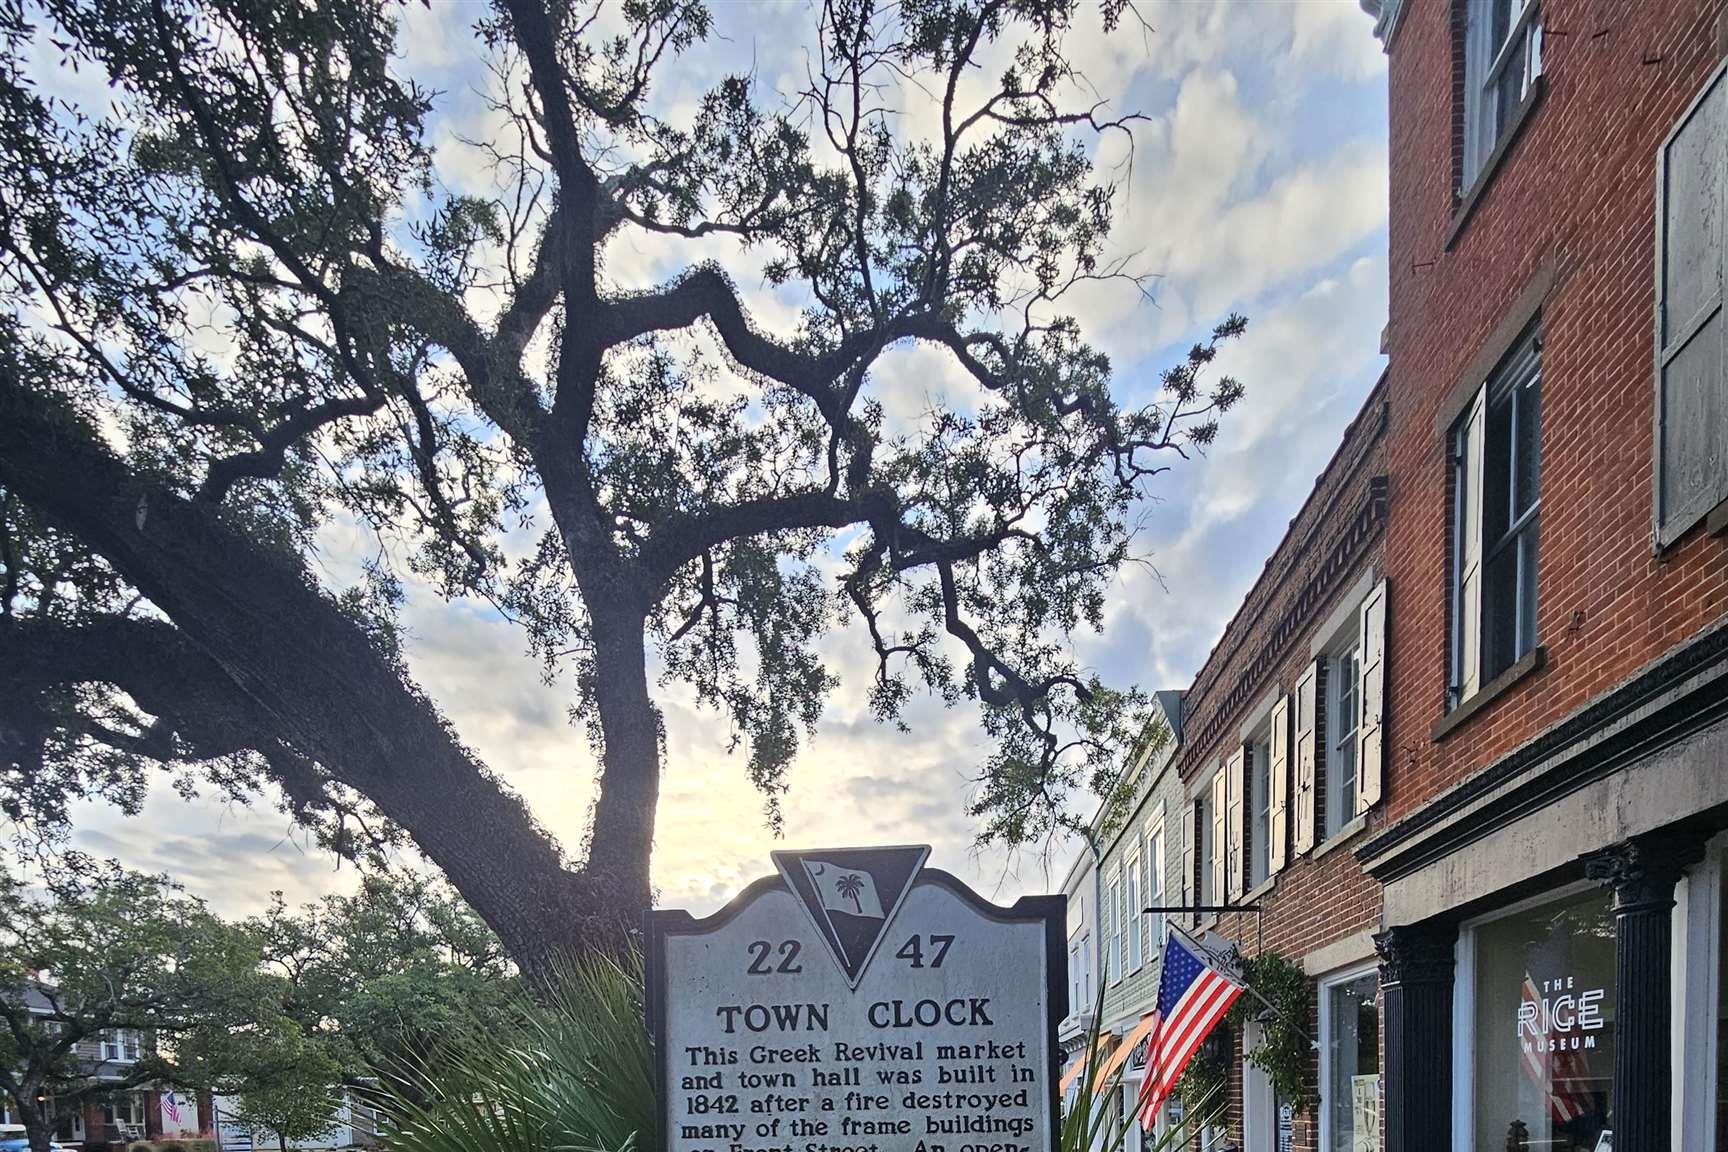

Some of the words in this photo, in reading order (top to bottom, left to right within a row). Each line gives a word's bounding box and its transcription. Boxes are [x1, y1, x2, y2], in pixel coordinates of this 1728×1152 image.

[747, 940, 802, 974] 22
[896, 935, 955, 968] 47
[1544, 977, 1573, 992] THE
[717, 1004, 829, 1033] TOWN
[868, 998, 993, 1028] CLOCK
[1518, 989, 1604, 1037] RICE
[686, 1046, 738, 1066] This
[750, 1044, 820, 1063] Greek
[835, 1042, 923, 1061] Revival
[937, 1041, 1025, 1059] market
[1523, 1036, 1595, 1053] MUSEUM
[681, 1072, 723, 1090] and
[739, 1072, 796, 1088] town
[813, 1069, 859, 1086] hall
[878, 1069, 922, 1084] was
[938, 1066, 996, 1083] built
[1012, 1064, 1034, 1082] in
[687, 1095, 739, 1114] 1842
[750, 1094, 809, 1116] after
[821, 1096, 834, 1111] a
[845, 1093, 889, 1111] fire
[902, 1090, 1028, 1114] destroyed
[681, 1123, 745, 1143] many
[756, 1119, 780, 1138] of
[790, 1119, 828, 1136] the
[841, 1117, 911, 1136] frame
[926, 1115, 1034, 1138] buildings
